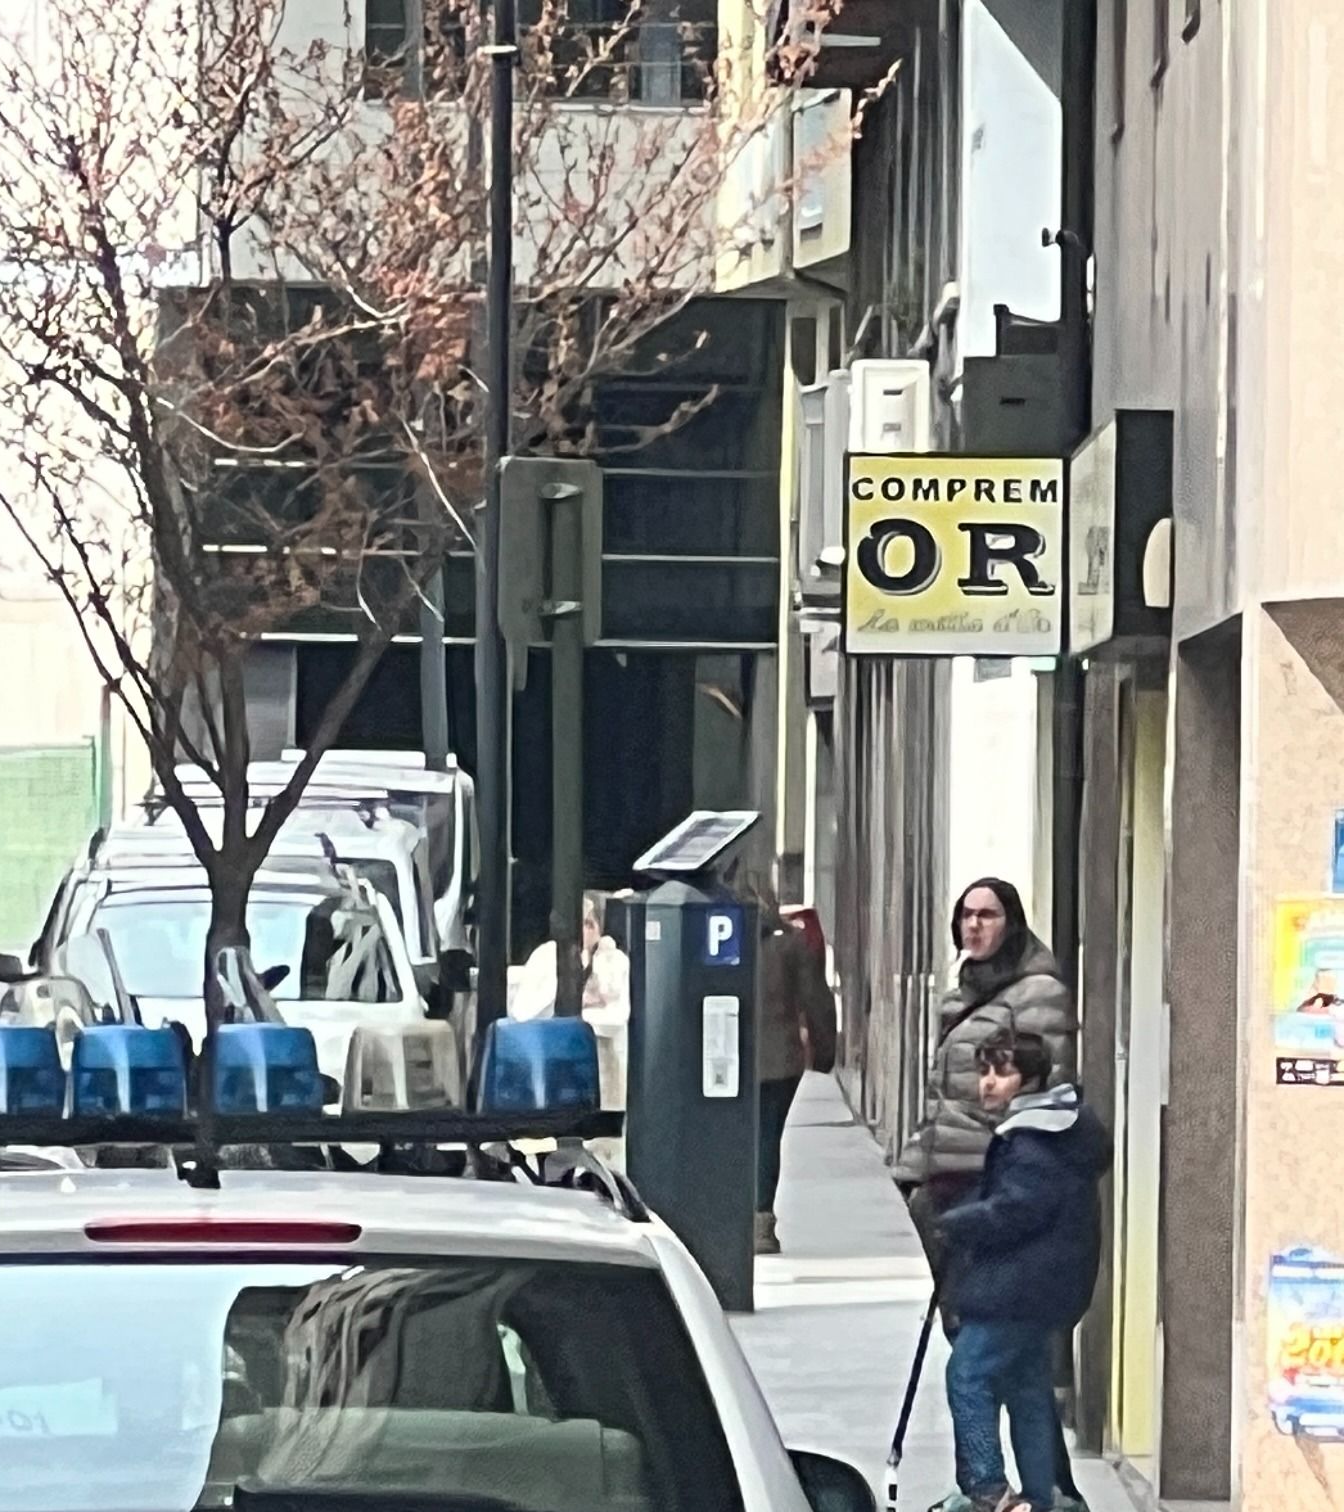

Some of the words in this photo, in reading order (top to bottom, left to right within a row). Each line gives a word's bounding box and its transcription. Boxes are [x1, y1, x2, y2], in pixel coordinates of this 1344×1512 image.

[851, 477, 1059, 503] COMPREM
[856, 518, 1056, 596] OR
[709, 915, 733, 956] P
